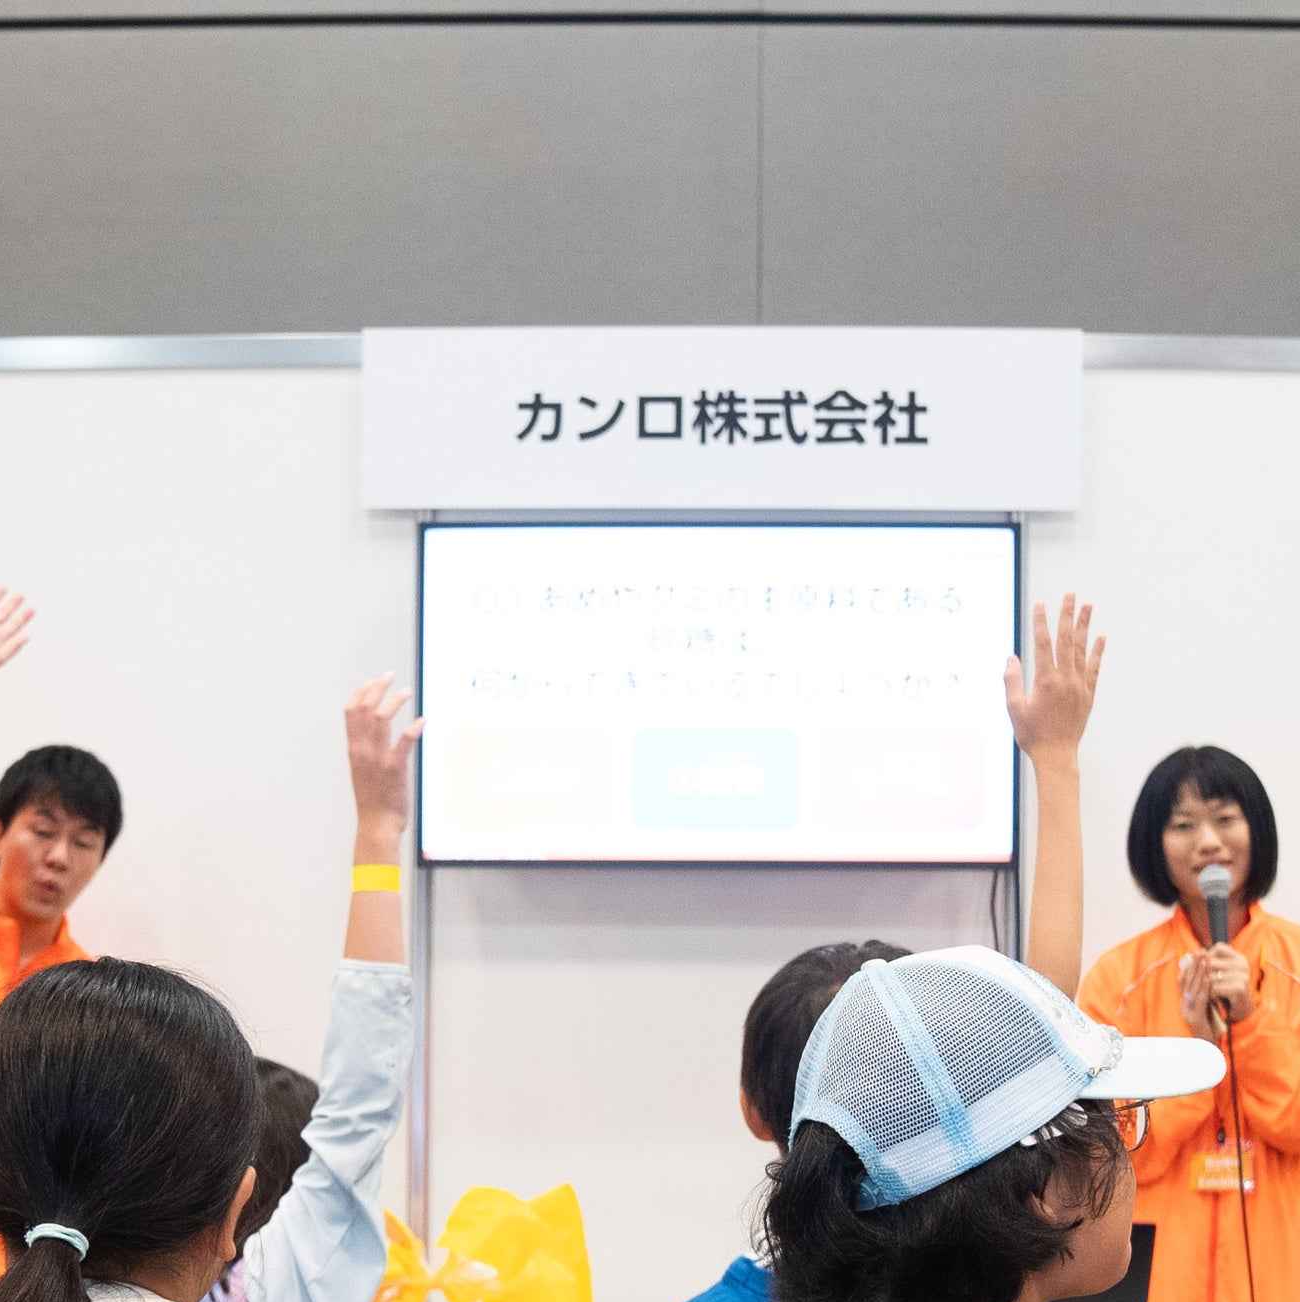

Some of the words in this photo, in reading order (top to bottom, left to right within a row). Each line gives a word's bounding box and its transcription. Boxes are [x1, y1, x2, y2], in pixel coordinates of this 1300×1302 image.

[514, 389, 929, 446] カンロ株式会社
